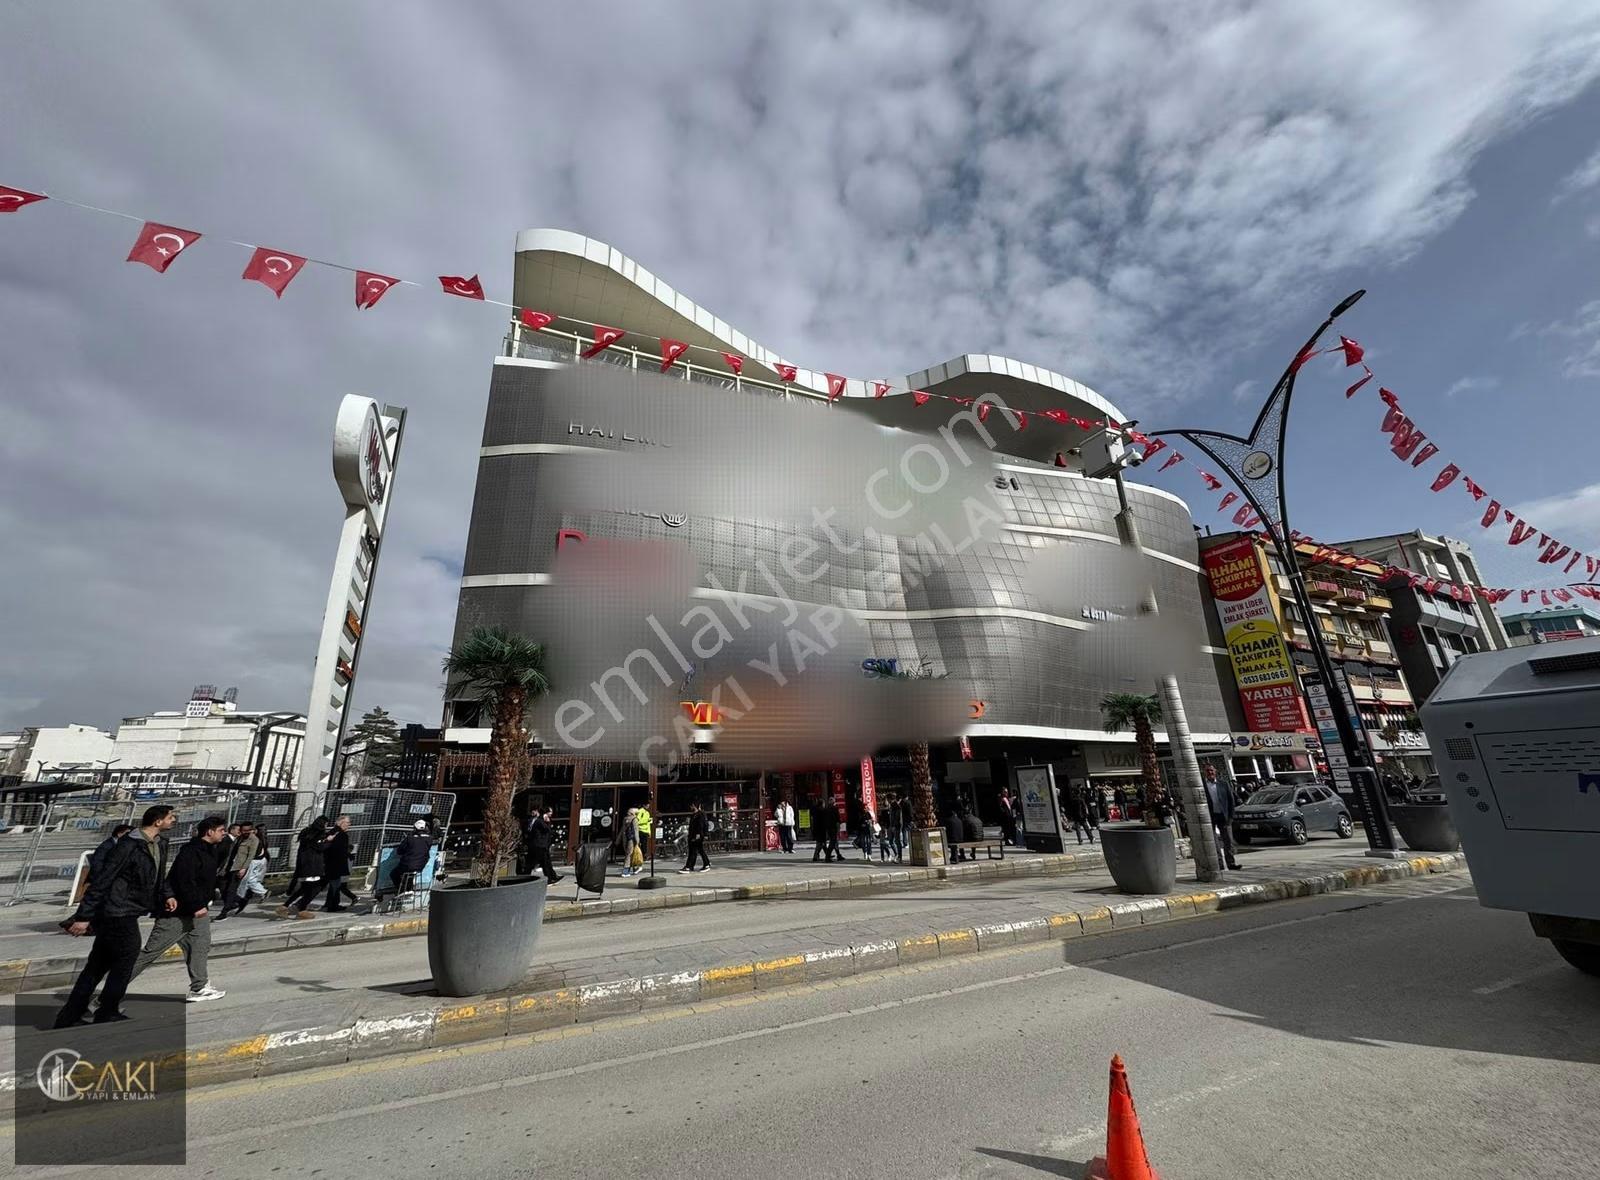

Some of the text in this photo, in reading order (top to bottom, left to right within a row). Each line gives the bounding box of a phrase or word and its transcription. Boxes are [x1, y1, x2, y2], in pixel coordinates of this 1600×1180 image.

[1209, 555, 1255, 579] İLHAMİ
[1213, 568, 1258, 589] ÇAKIRTAŞ
[1216, 582, 1243, 596] EMLAK
[1223, 612, 1245, 624] EMLAK
[1232, 635, 1279, 656] İLHAMİ
[1235, 648, 1282, 666] ÇAKIRTAŞ
[1238, 663, 1266, 675] EMLAK
[1244, 686, 1293, 701] YAREN
